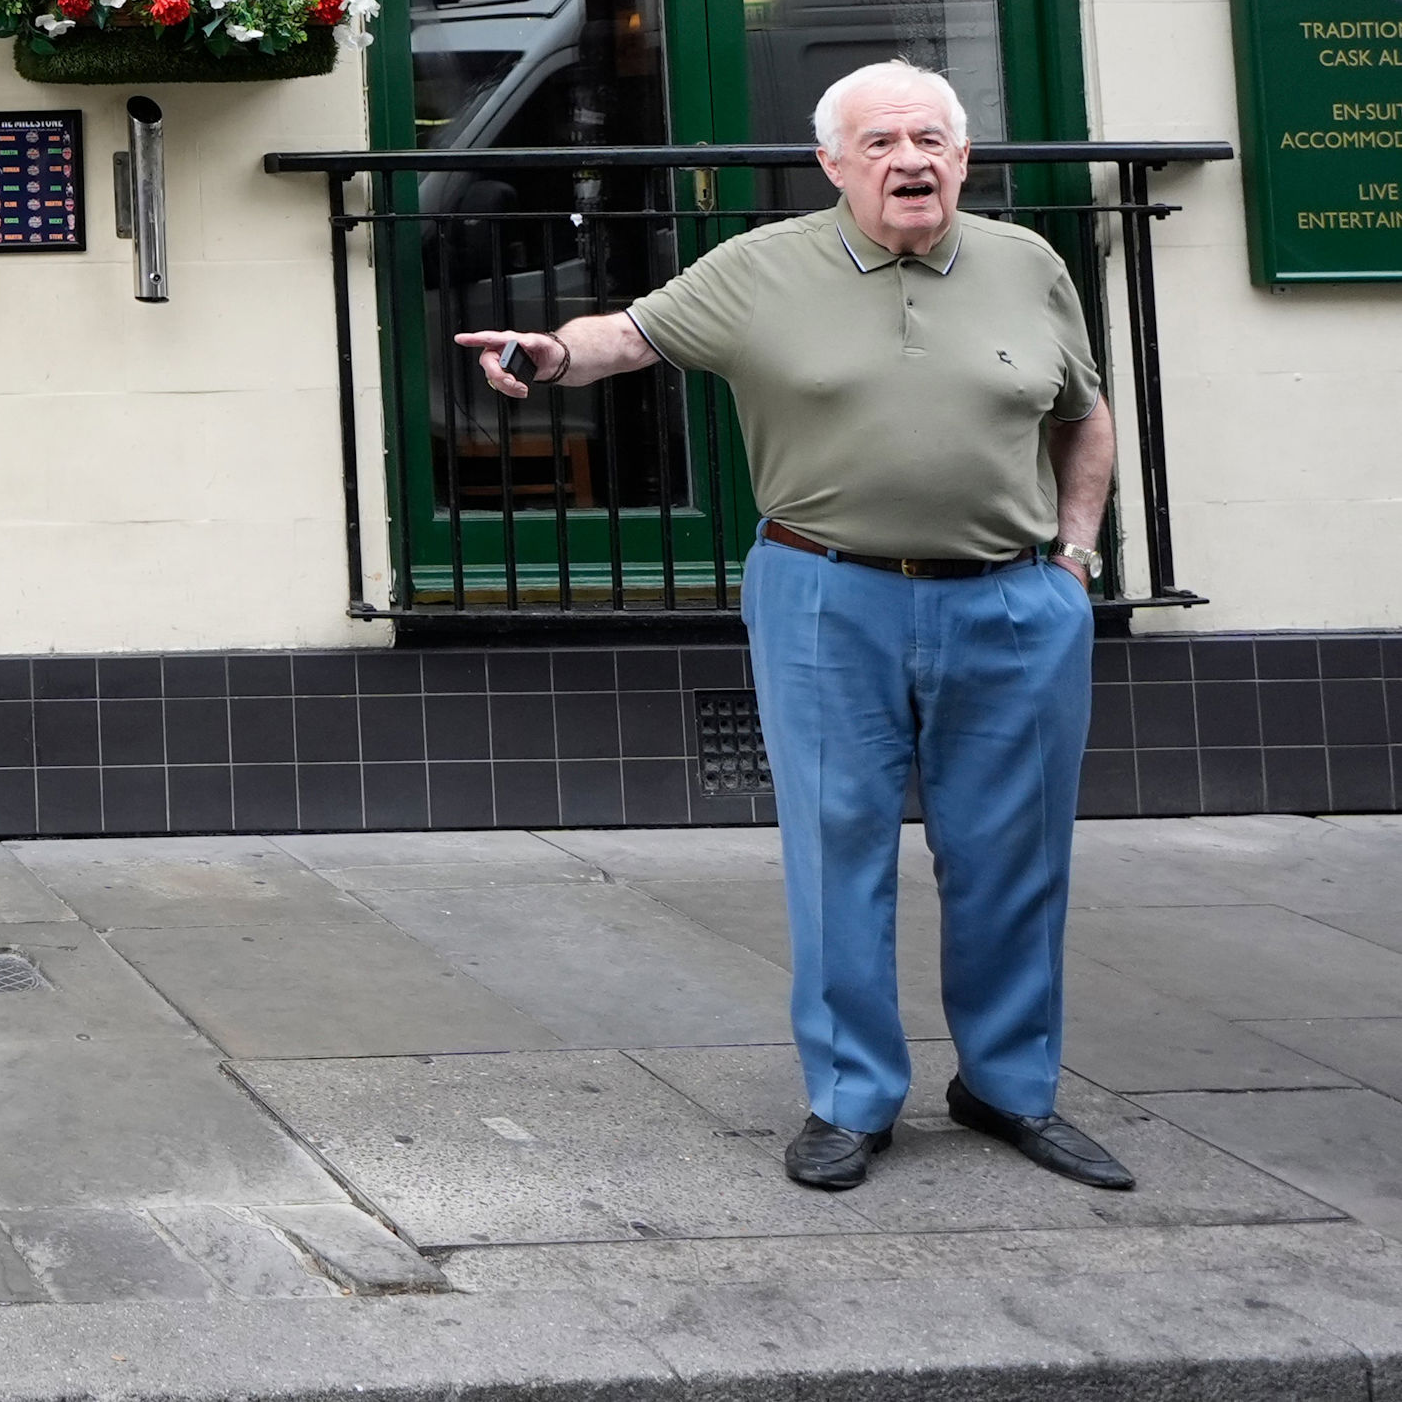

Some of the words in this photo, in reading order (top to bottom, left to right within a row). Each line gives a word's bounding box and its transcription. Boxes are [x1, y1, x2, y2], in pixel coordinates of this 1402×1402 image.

[1300, 21, 1402, 39] TRADITIO
[1319, 49, 1373, 67] CASK
[14, 120, 64, 128] MILLSTONE
[1358, 184, 1399, 200] LIVE
